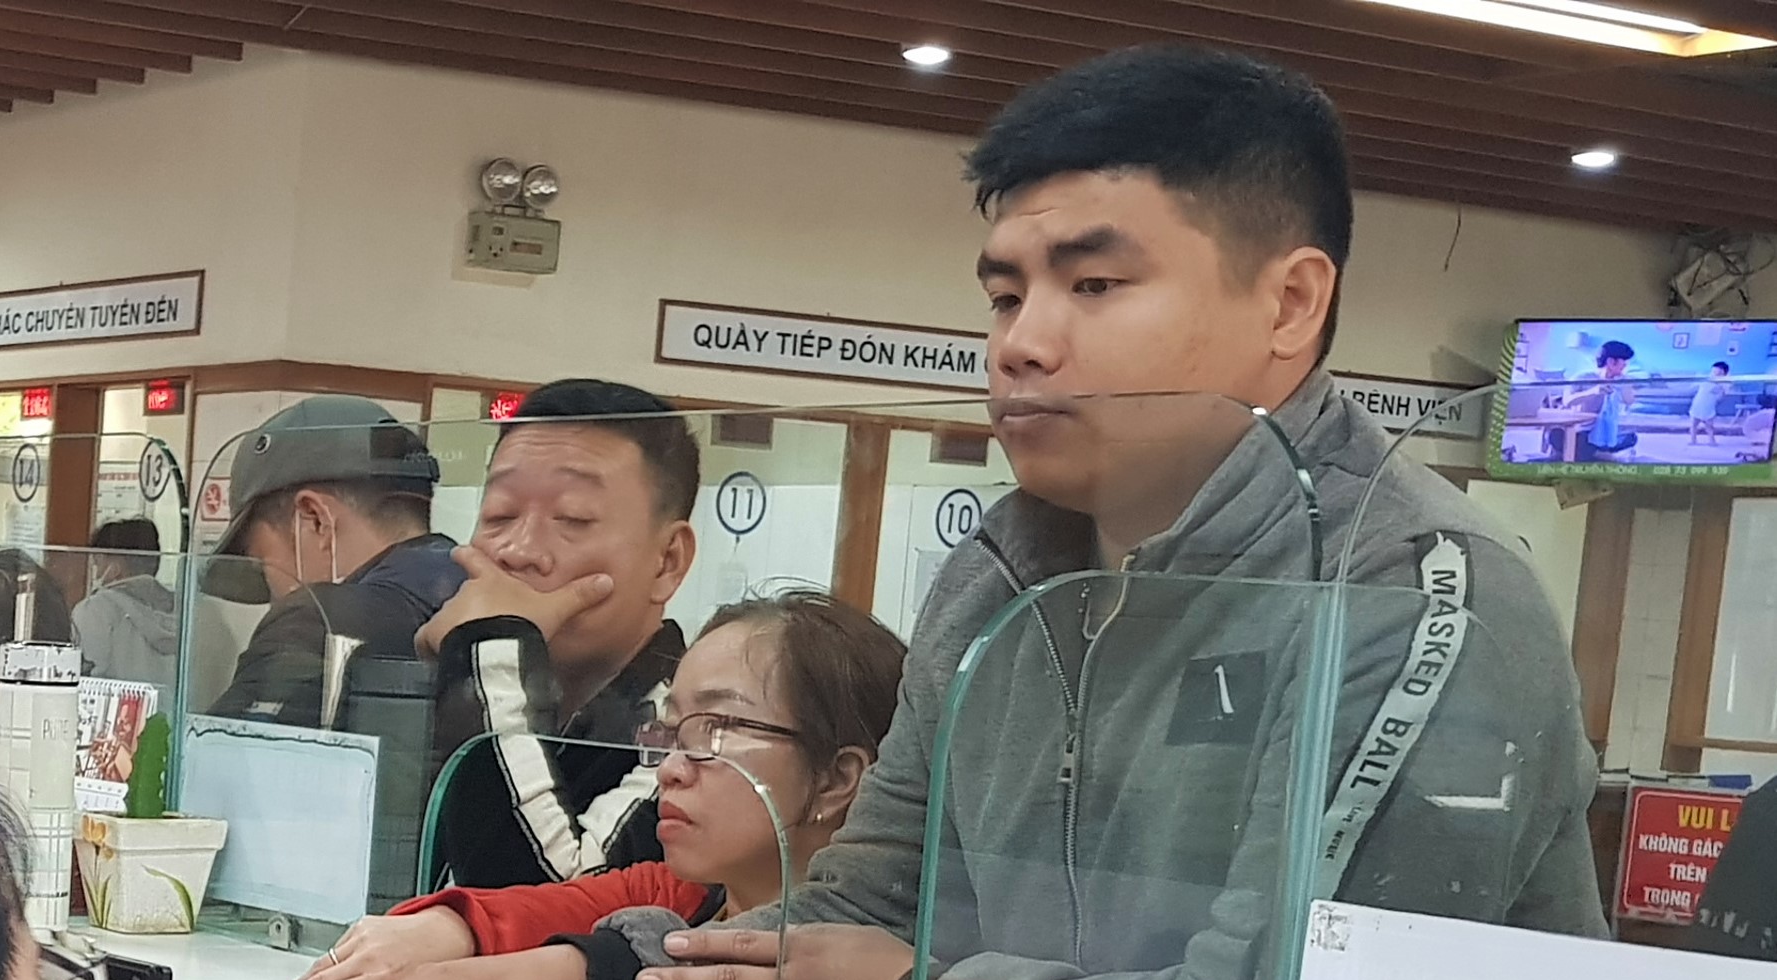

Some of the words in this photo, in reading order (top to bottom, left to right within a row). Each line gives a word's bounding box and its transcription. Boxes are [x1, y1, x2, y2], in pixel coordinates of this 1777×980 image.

[839, 332, 896, 366] ĐÓN
[902, 341, 977, 375] KHÁM
[18, 456, 35, 489] 14
[145, 453, 163, 488] 13
[730, 486, 754, 521] 11
[947, 502, 973, 536] 10
[1402, 568, 1459, 698] MASKED
[1350, 715, 1415, 790] BALL
[1678, 804, 1714, 830] VUI
[1638, 832, 1690, 856] KHÔNG
[1669, 861, 1707, 883] TRÊN
[1642, 885, 1691, 907] TRONG
